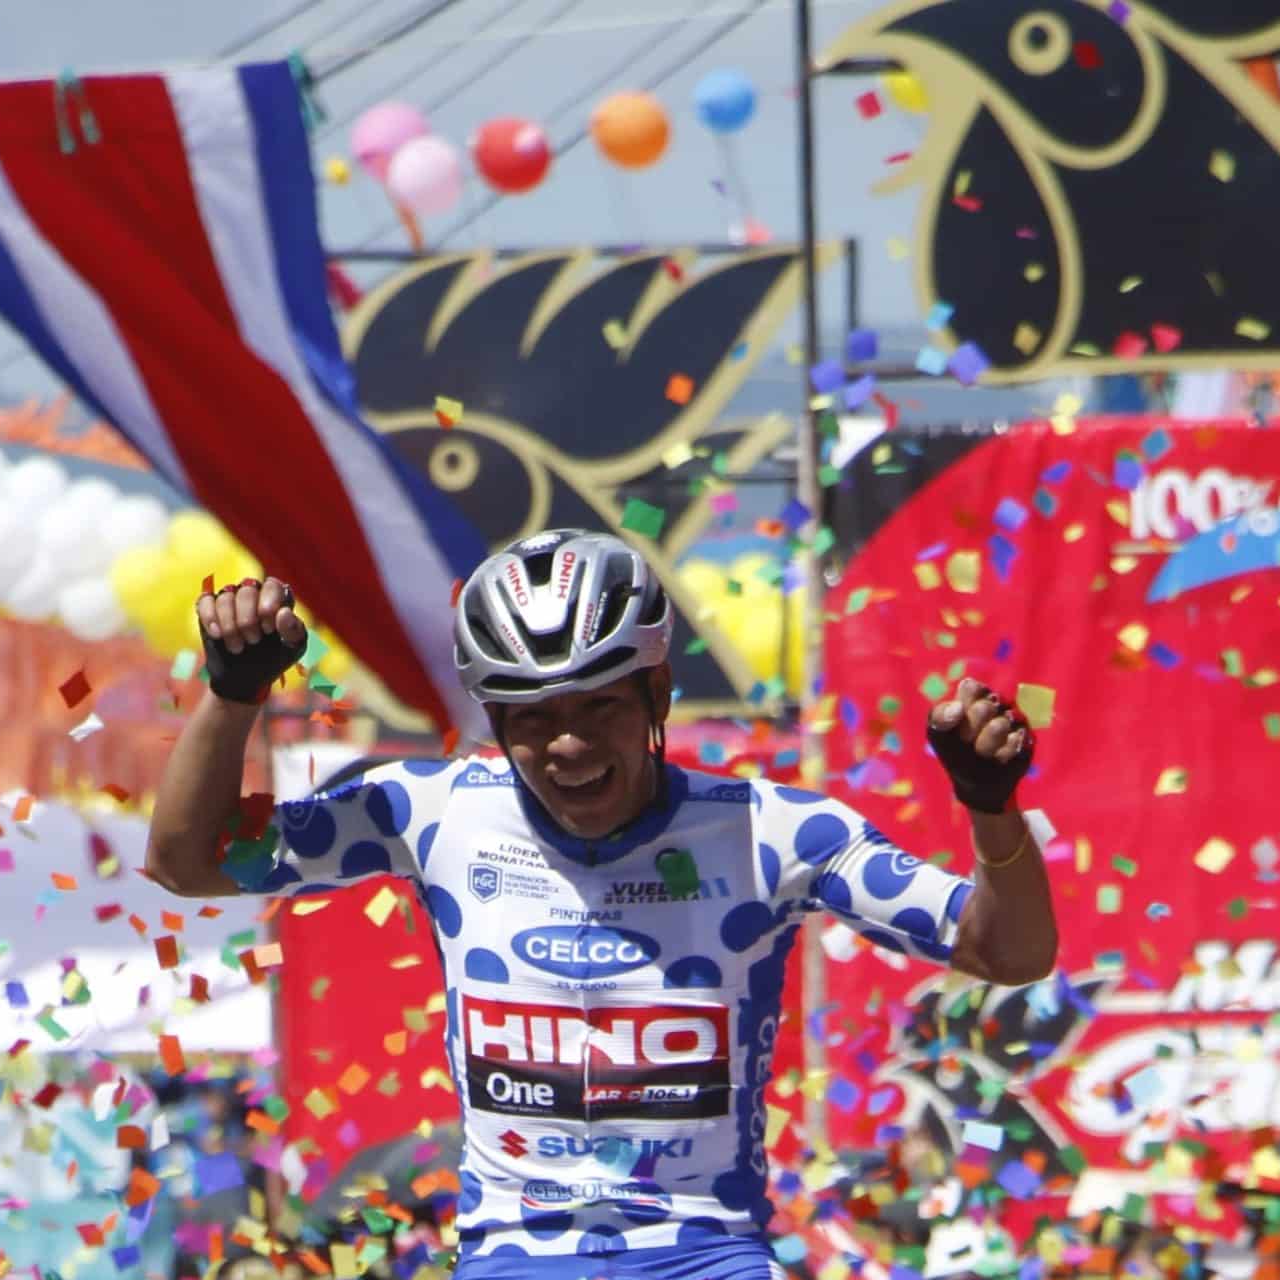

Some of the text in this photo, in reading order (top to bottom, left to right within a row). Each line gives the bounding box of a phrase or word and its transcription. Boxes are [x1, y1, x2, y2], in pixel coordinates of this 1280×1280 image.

[1129, 467, 1280, 538] 100%
[506, 561, 529, 607] HINO
[558, 551, 576, 599] HINO
[612, 881, 670, 896] VUEL
[550, 907, 623, 922] PINTURAS
[525, 936, 644, 964] CELCO
[468, 1008, 718, 1066] HINO
[486, 1072, 554, 1106] One
[536, 1136, 694, 1157] SUKI
